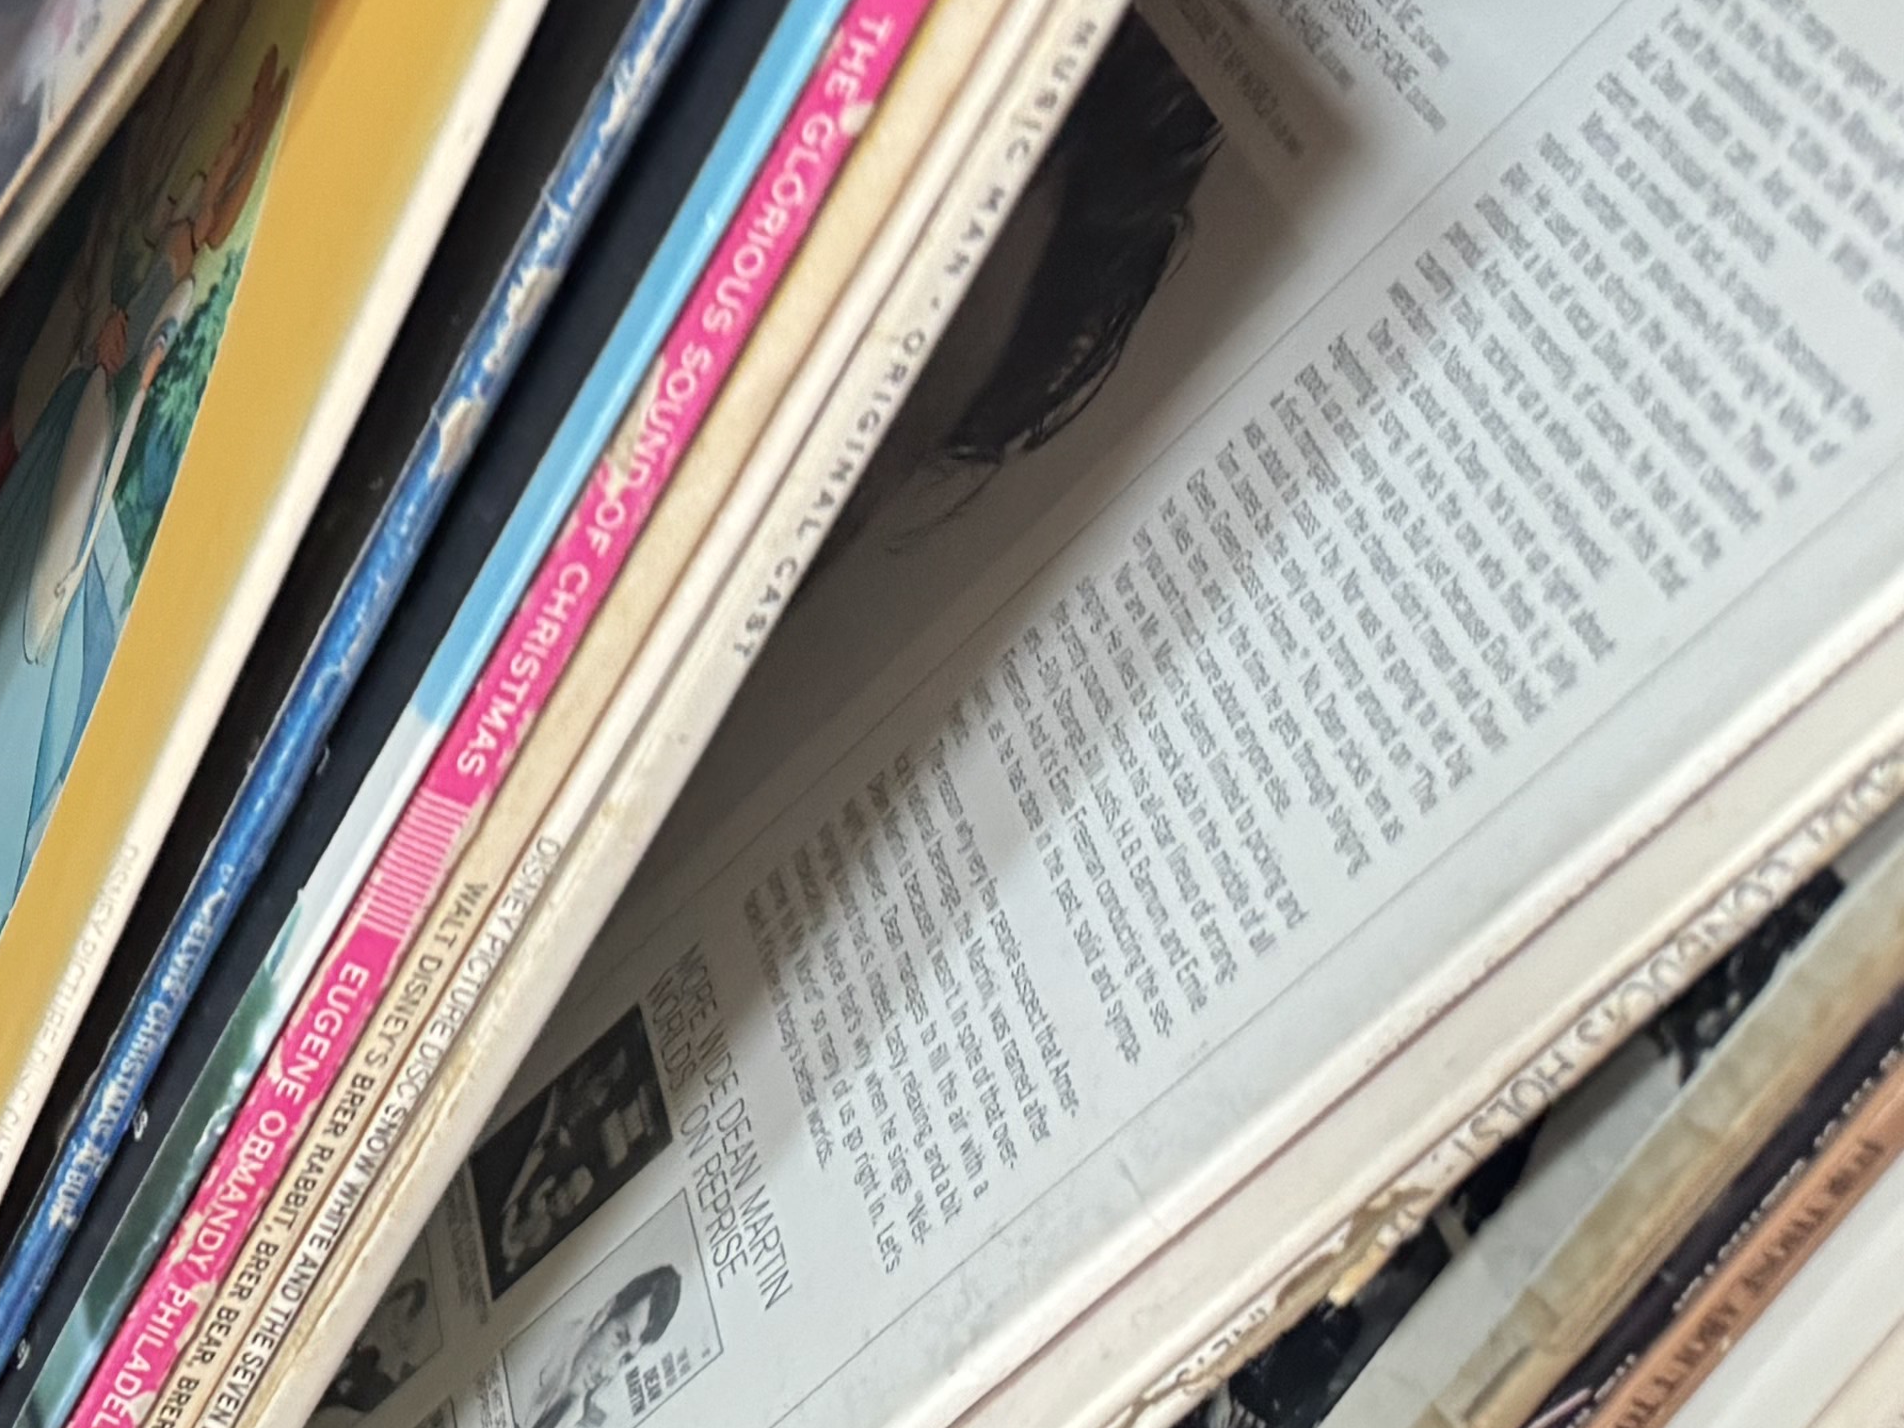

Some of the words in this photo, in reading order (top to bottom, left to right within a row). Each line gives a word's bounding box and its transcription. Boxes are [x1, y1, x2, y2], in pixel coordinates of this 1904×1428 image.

[823, 7, 894, 100] THE
[1003, 16, 1101, 166] MUSIC
[693, 107, 843, 338] GLORIOUS
[940, 181, 1009, 278] MAN
[613, 339, 714, 487] SOUND
[791, 324, 929, 545] ORIGINAL
[575, 493, 627, 554] OF
[727, 551, 802, 658] CAST
[452, 556, 594, 783] CHRISTMAS
[432, 876, 490, 950] WALT
[492, 834, 564, 933] DISNEY
[275, 959, 371, 1105] EUGENE
[360, 950, 447, 1073] DISNEY'S
[428, 929, 509, 1043] PICTURE
[86, 998, 174, 1140] CHRISTMAS
[321, 1068, 378, 1141] BRER
[391, 1038, 445, 1106] DISC
[695, 1019, 739, 1110] WIDE
[348, 1099, 410, 1180] SNOW
[678, 1097, 715, 1163] ON
[714, 1094, 762, 1195] DEAN
[261, 1138, 337, 1242] RABBIT,
[304, 1176, 364, 1256] WHITE
[691, 1148, 748, 1293] REPRISE
[226, 1236, 281, 1306] BRER
[276, 1251, 321, 1306] AND
[737, 1180, 793, 1314] MARTIN
[182, 1300, 242, 1376] BEAR,
[248, 1300, 293, 1353] THE
[204, 1347, 265, 1428] SEVEN
